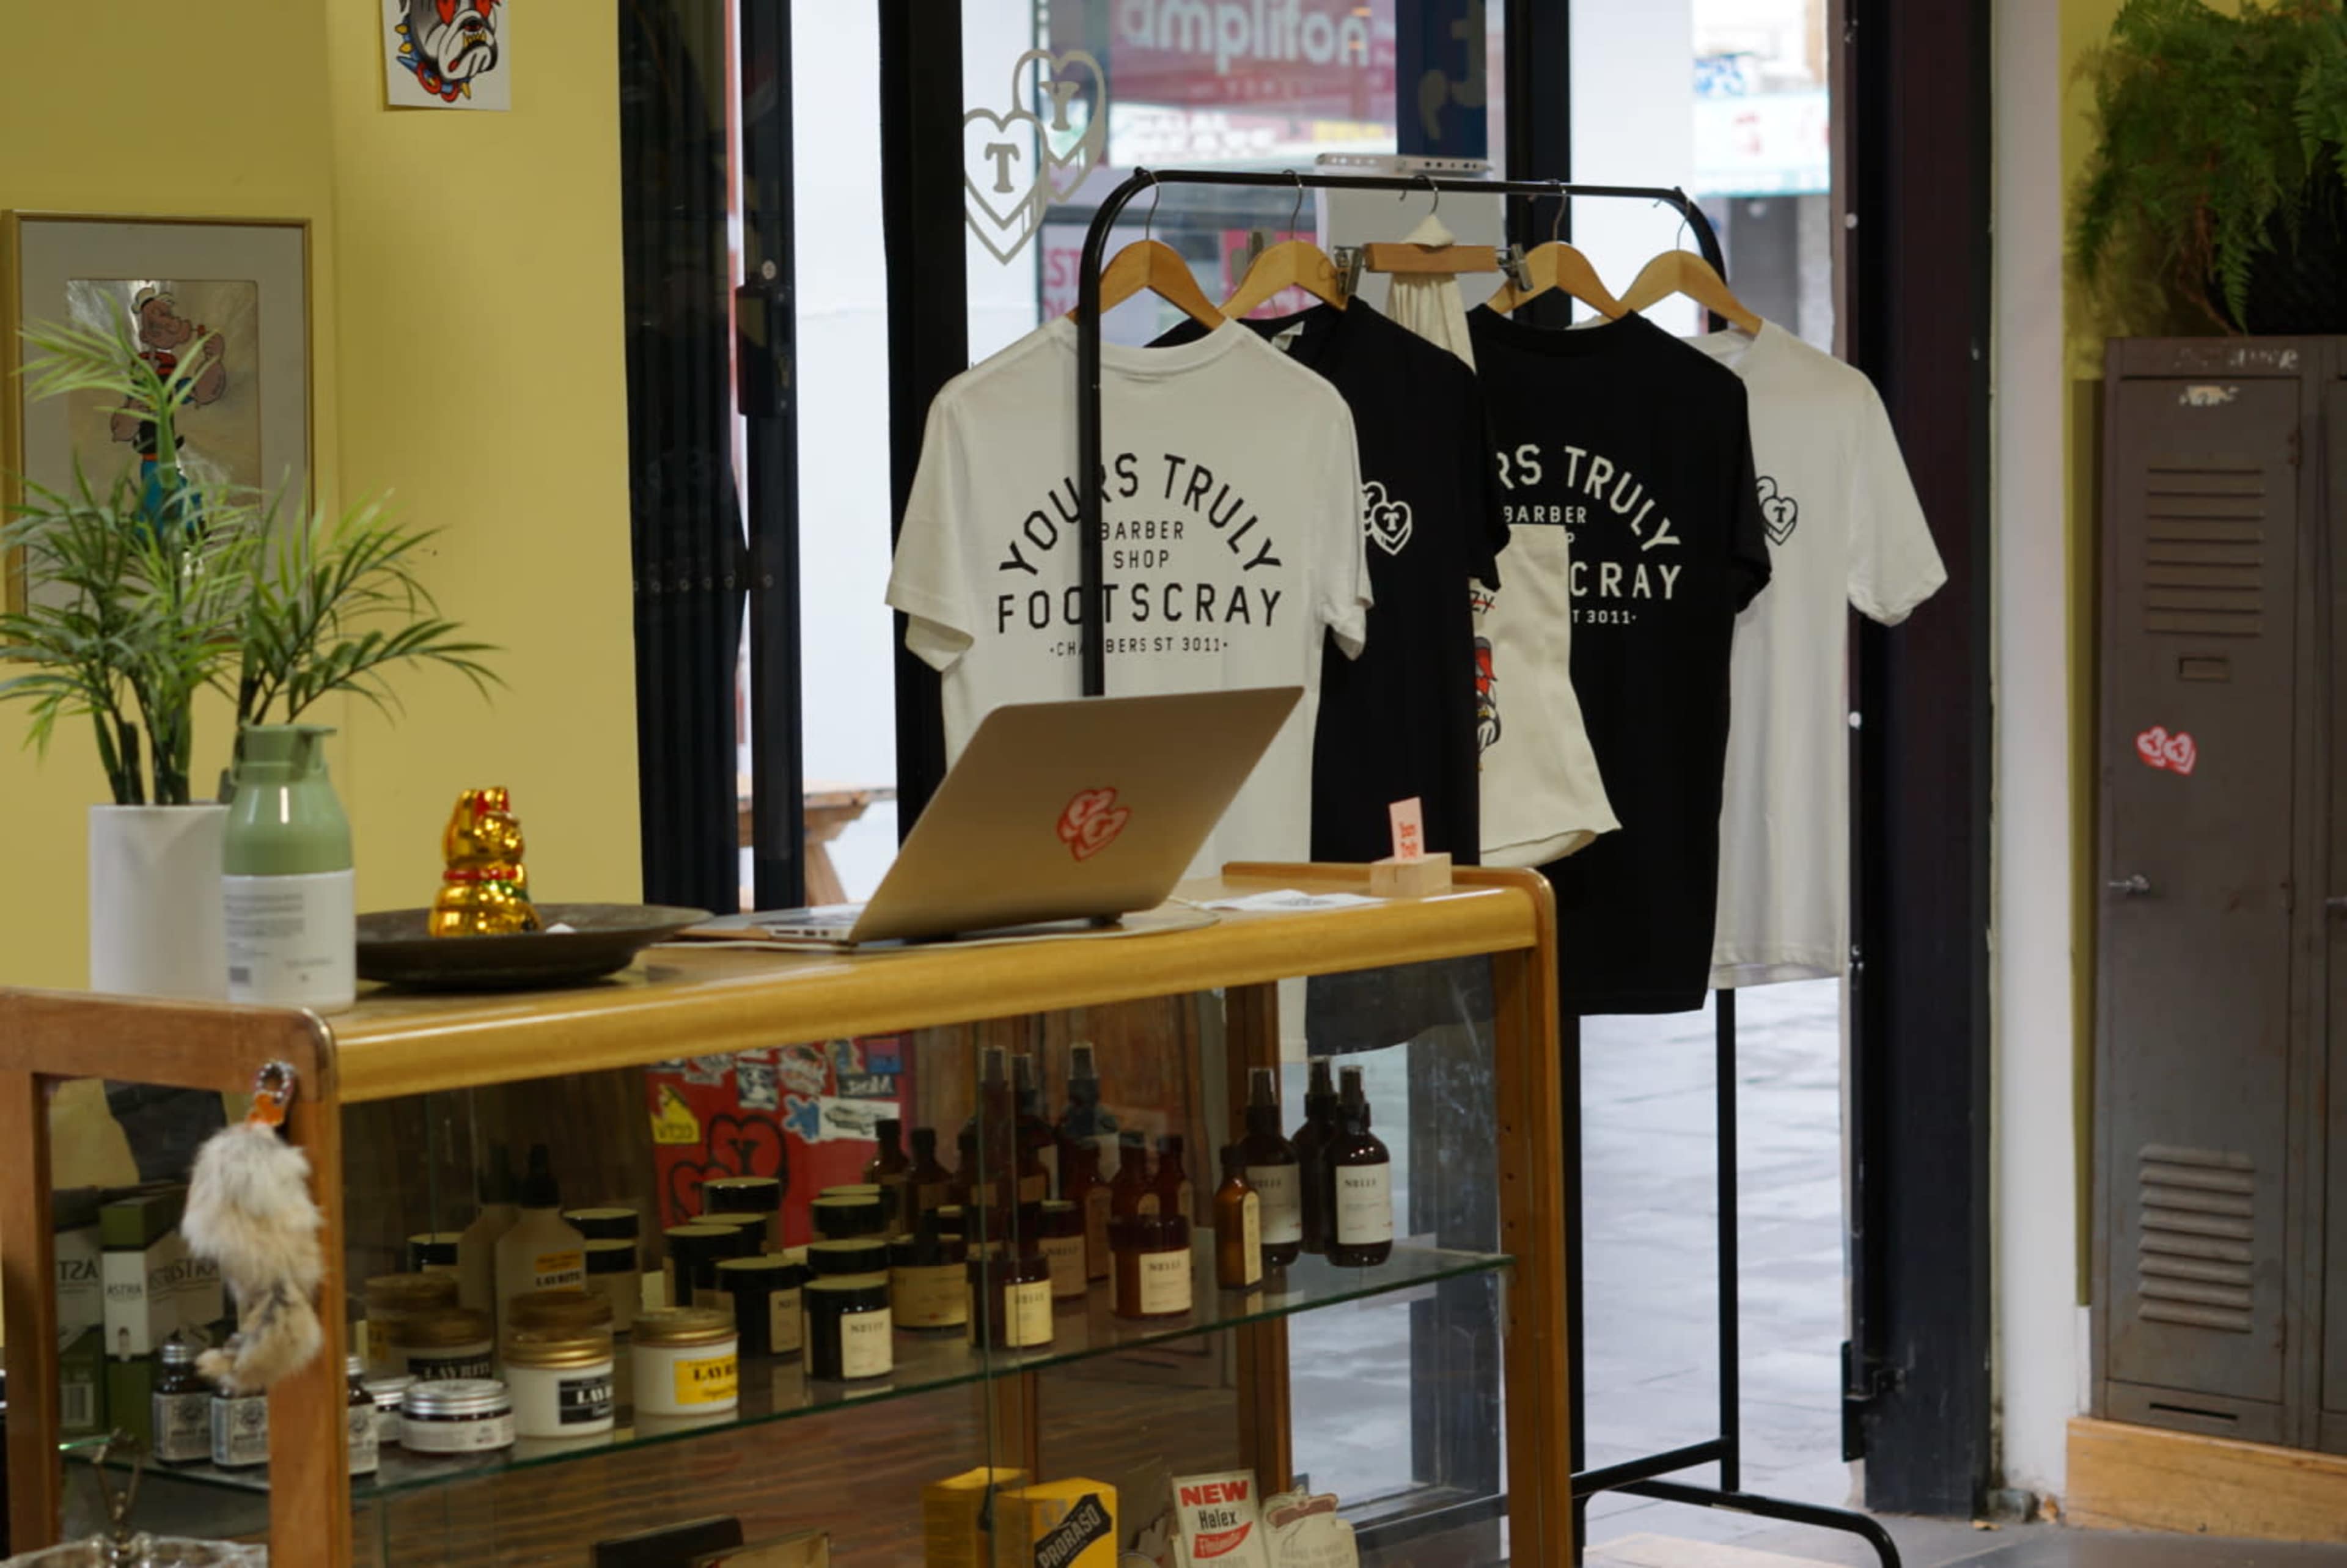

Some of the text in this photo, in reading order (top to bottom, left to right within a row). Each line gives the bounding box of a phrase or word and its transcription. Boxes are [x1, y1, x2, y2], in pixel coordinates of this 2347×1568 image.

[1122, 0, 1369, 73] amplifon
[985, 143, 1019, 194] T
[1164, 453, 1282, 572] TRULY
[1565, 445, 1681, 552] TRULY
[1100, 521, 1184, 541] BARBER
[1113, 549, 1169, 569] SHOP
[999, 582, 1282, 634] FOOTSCRAY
[1154, 637, 1173, 652] ST
[1180, 1479, 1248, 1506] NEW
[1037, 1504, 1102, 1568] PRORASO
[1199, 1508, 1238, 1530] Halex
